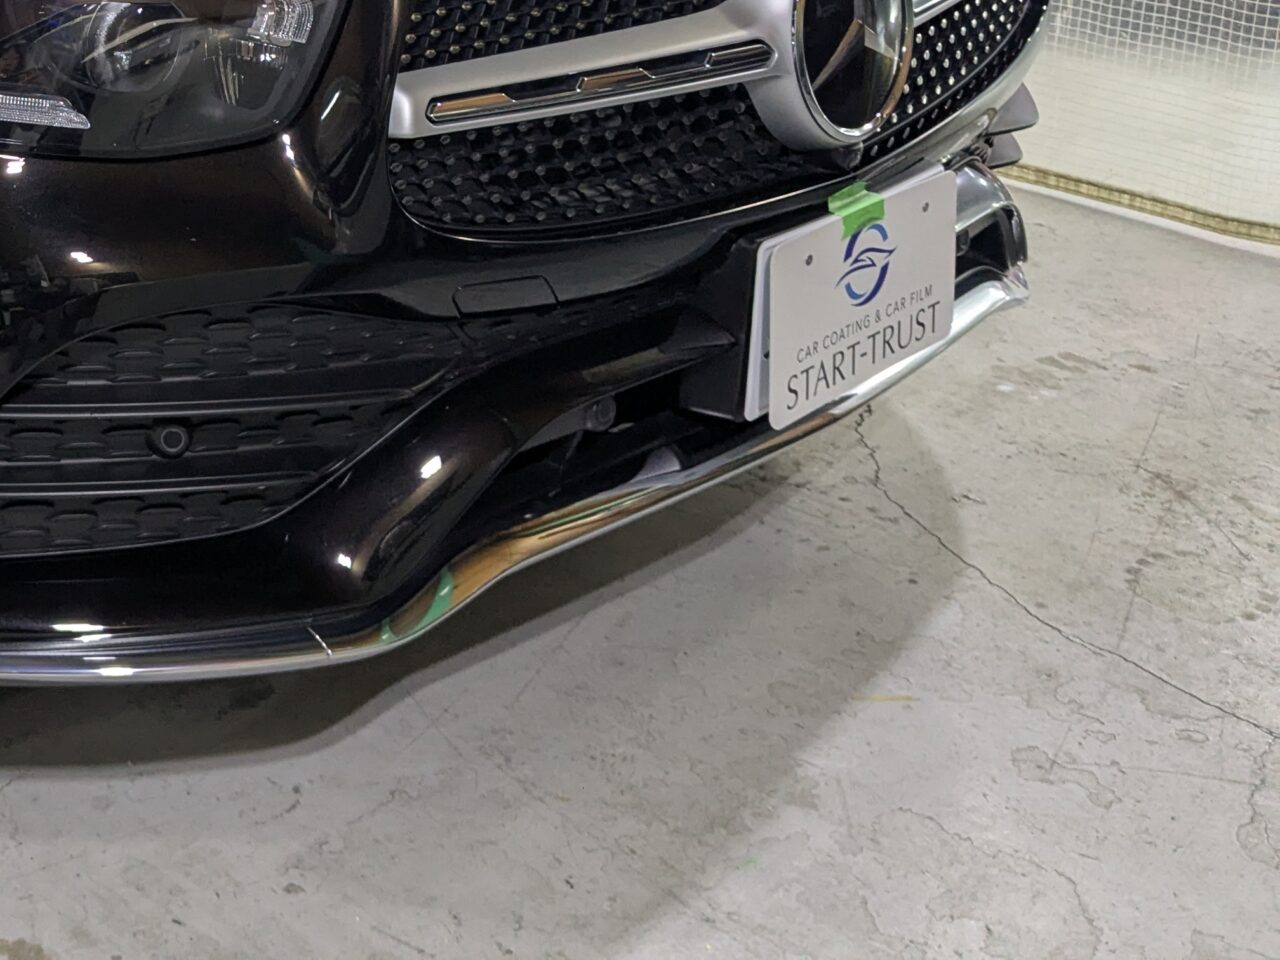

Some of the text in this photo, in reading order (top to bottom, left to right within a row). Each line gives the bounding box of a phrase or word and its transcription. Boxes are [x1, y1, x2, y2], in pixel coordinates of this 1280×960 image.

[786, 300, 941, 411] START-TRUST
[796, 284, 933, 363] CAR COATING & CAR FILM
